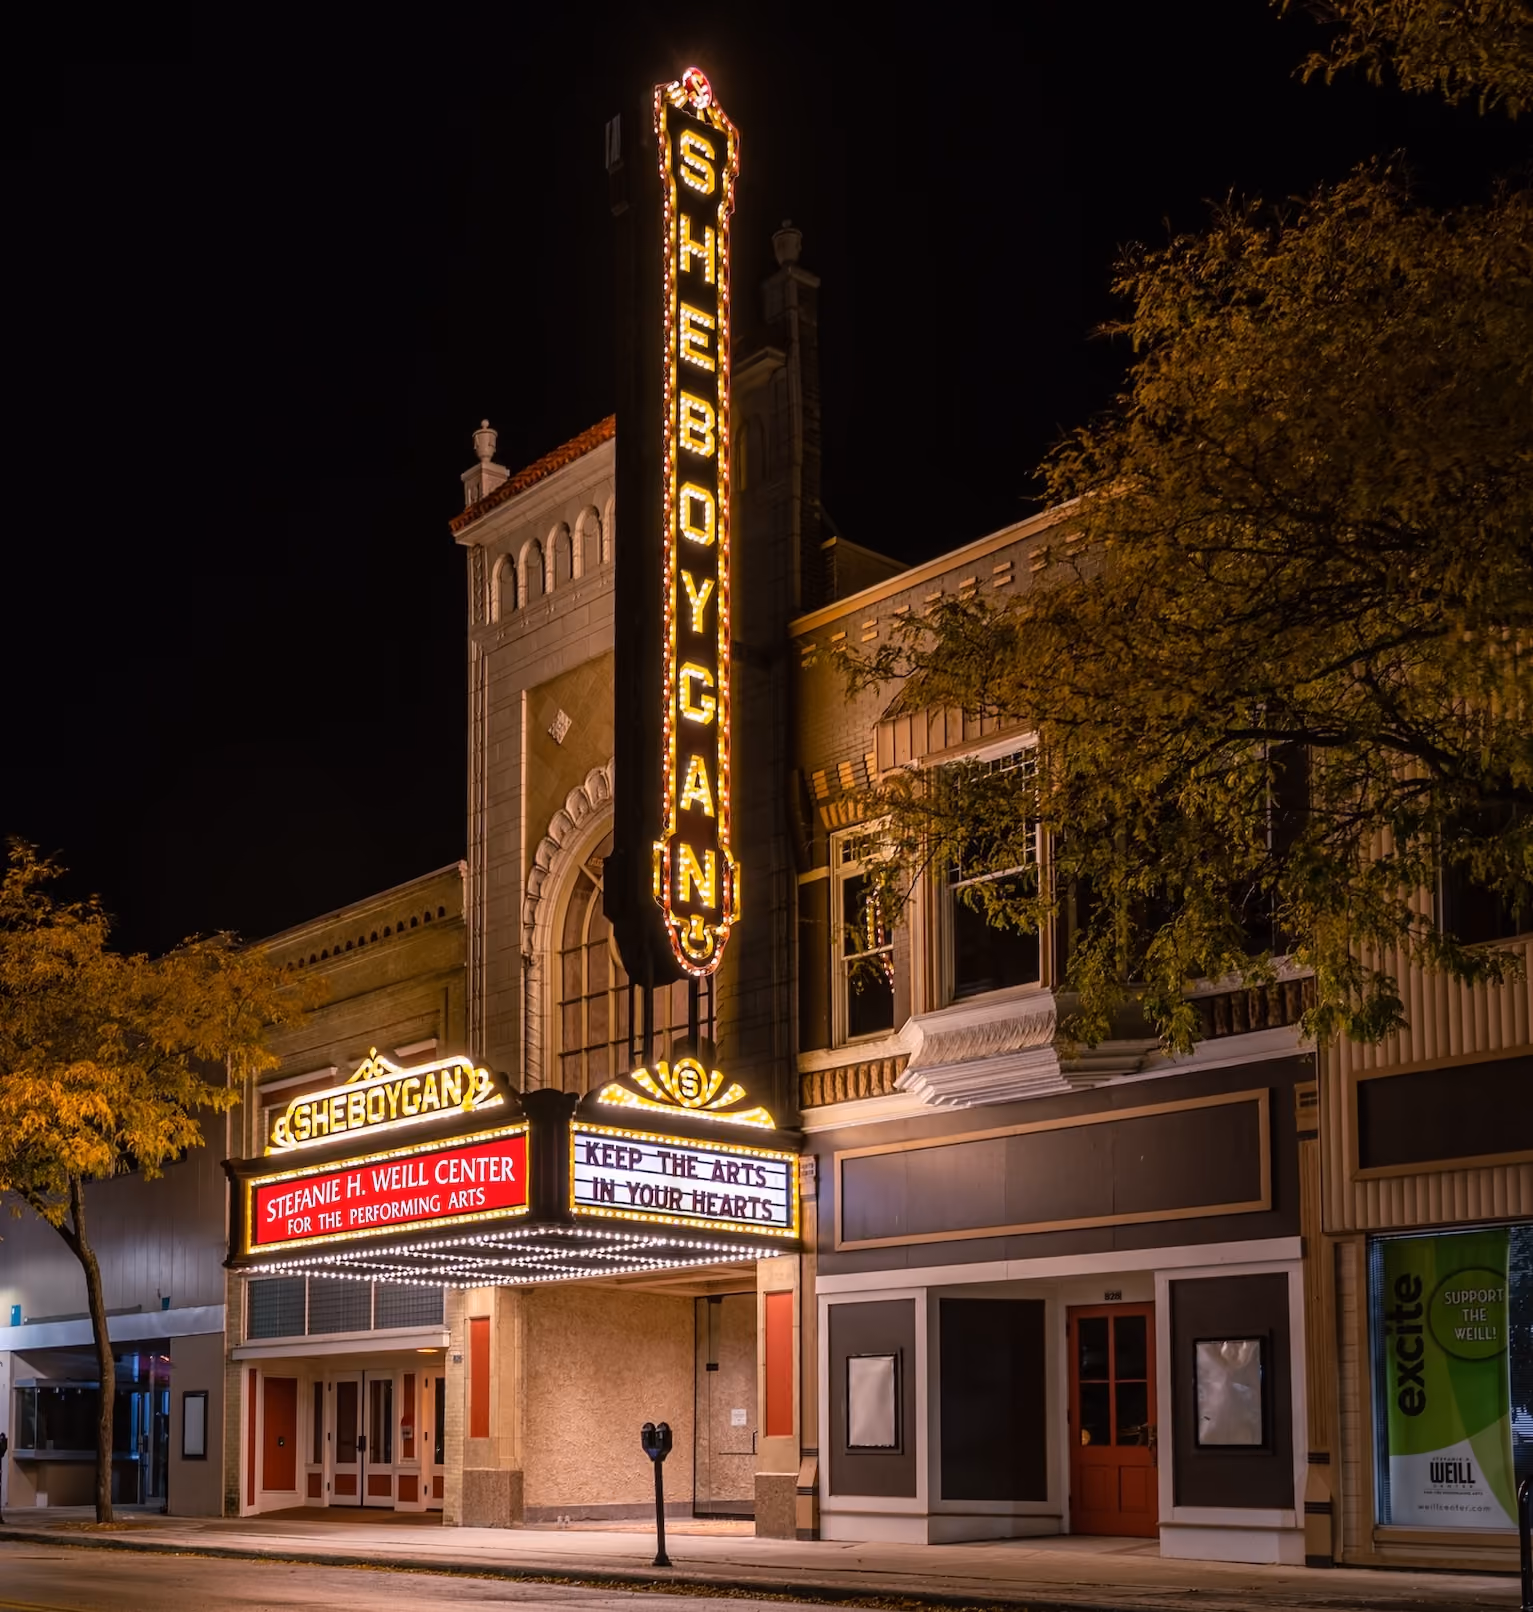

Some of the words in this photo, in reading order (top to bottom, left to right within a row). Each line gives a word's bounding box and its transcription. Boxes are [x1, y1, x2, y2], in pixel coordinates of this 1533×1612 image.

[679, 129, 716, 908] SHEBOYGAN
[293, 1065, 463, 1140] SHEBOYGAN
[679, 1068, 700, 1098] S
[585, 1140, 643, 1170] KEEP
[657, 1150, 699, 1179] THE
[711, 1159, 767, 1188] ARTS
[266, 1178, 341, 1222] STEFANIE
[346, 1174, 366, 1198] H.
[372, 1161, 429, 1192] WEILL
[434, 1156, 515, 1184] CENTER
[287, 1216, 312, 1235] FOR
[318, 1211, 343, 1230] THE
[350, 1194, 441, 1225] PERFORMING
[448, 1187, 486, 1209] ARTS
[592, 1176, 615, 1203] IN
[626, 1180, 683, 1211] YOUR
[692, 1189, 773, 1221] HEARTS
[1444, 1288, 1505, 1305] SUPPORT
[1462, 1308, 1488, 1322] THE
[1386, 1273, 1426, 1417] excite
[1454, 1326, 1497, 1341] WEILL!
[1429, 1462, 1476, 1484] WEILL
[1418, 1503, 1491, 1513] weillcenter.com
